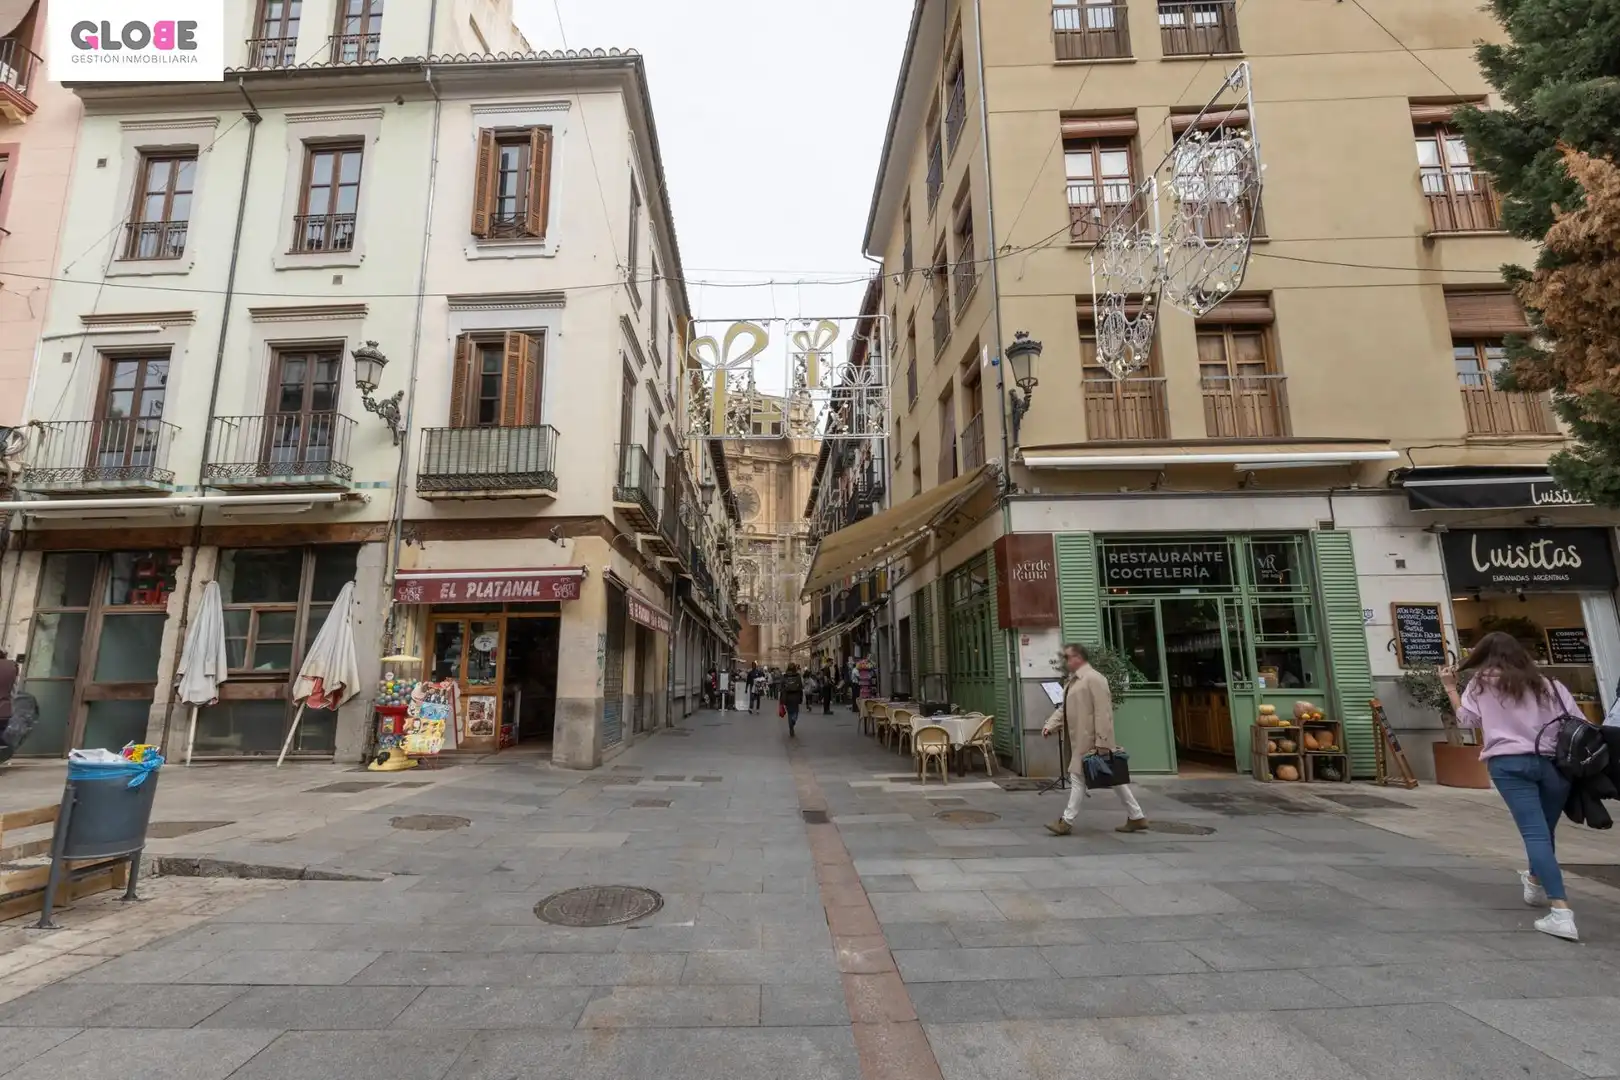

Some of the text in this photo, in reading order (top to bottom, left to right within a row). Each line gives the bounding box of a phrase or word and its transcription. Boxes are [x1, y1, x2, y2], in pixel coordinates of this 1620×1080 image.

[1109, 551, 1224, 564] RESTAURANTE
[1471, 533, 1582, 572] Luisitas
[1110, 565, 1210, 579] COCTELERÍA
[1492, 574, 1530, 582] EMPANADAS
[440, 580, 540, 599] EL PLATANAL
